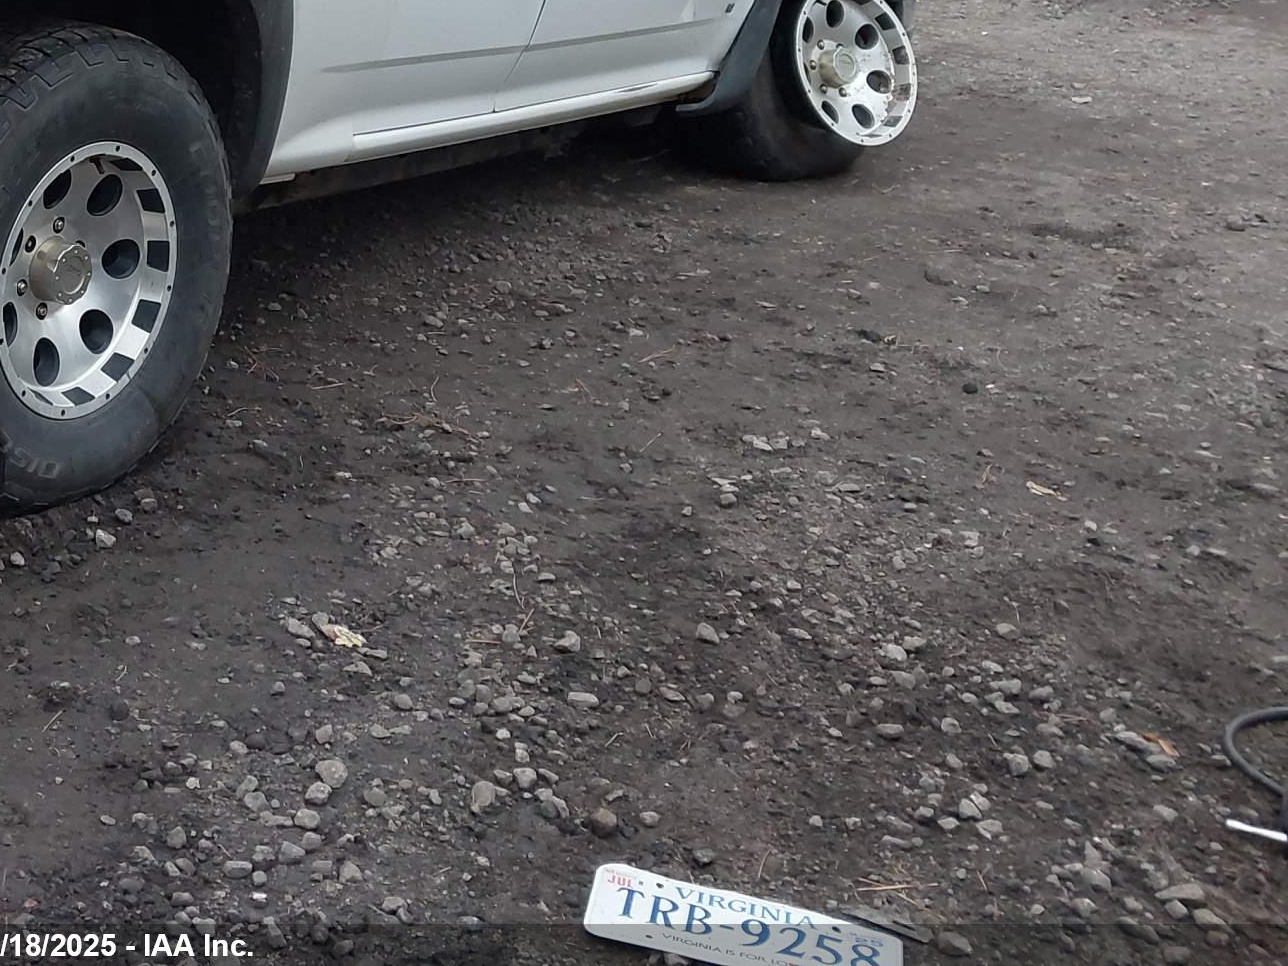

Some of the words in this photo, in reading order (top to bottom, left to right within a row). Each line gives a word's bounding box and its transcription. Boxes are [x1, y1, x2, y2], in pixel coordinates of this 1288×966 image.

[616, 887, 881, 966] TRB-9258
[675, 886, 818, 930] VIRGINIA
[662, 932, 722, 954] VIRGINIA
